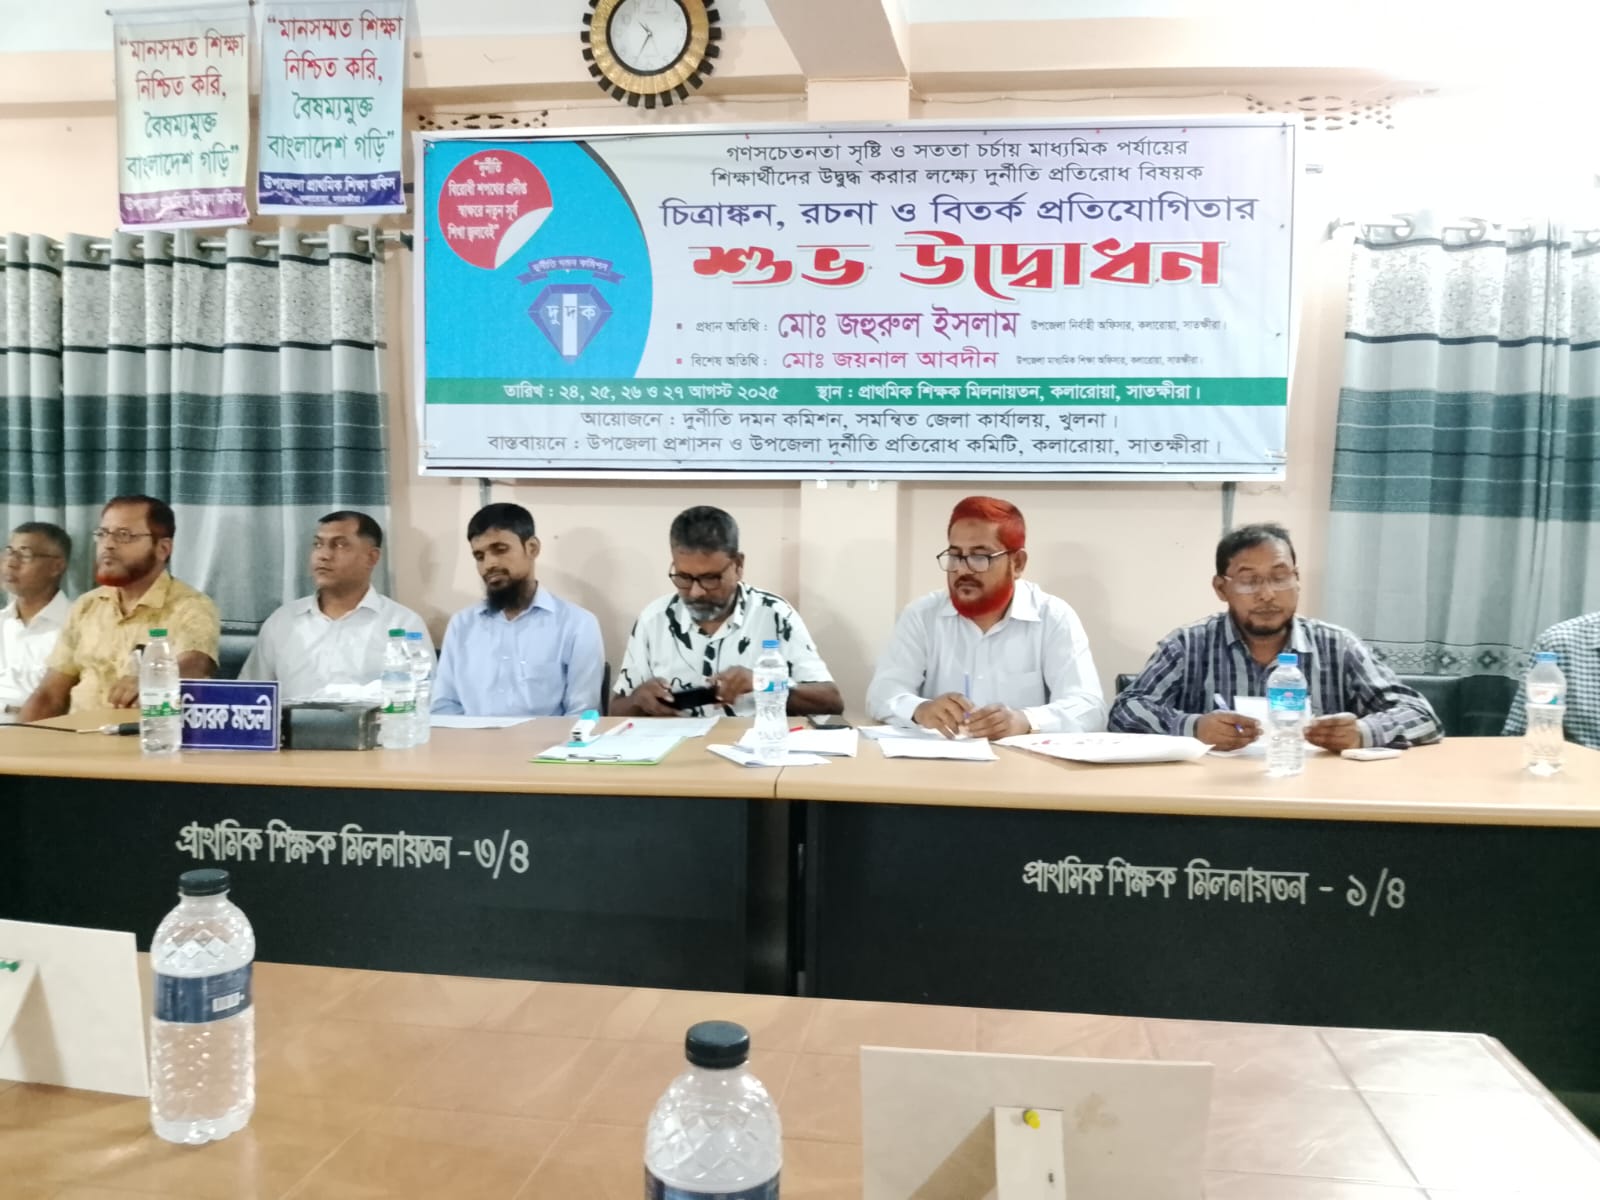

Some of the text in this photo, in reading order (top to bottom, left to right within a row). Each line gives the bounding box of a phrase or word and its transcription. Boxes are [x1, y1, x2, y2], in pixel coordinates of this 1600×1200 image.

[360, 9, 404, 41] শিক্ষা
[204, 28, 245, 58] শিক্ষা
[283, 49, 384, 85] নিশ্চিত করি,
[136, 66, 226, 100] নিশ্চিত করি,
[292, 92, 374, 126] বৈষম্যমুক্ত
[144, 112, 218, 141] বৈষম্যমুক্ত
[268, 135, 347, 161] বাংলাদেশ
[726, 138, 1189, 165] গণসচেতনতা সৃষ্টি ও সততা চর্চায় মাধ্যমিক পর্যায়ের
[126, 152, 193, 178] বাংলাদেশ
[711, 162, 1204, 189] শিক্ষার্থীদের উদ্বুদ্ধ করার লক্ষ্যে দুর্নীতি প্রতিরোধ বিষয়ক
[659, 190, 1260, 231] চিত্রাঙ্কন, রচনা ও বিতর্ক প্রতিযোগিতার
[688, 230, 1226, 301] শুভ উদ্বোধন
[696, 321, 722, 332] প্রধান
[726, 318, 760, 332] অতিথি
[778, 311, 826, 339] মোঃ
[835, 312, 924, 343] জহুরুল
[932, 304, 1021, 341] ইসলাম
[1031, 320, 1066, 331] উপজেলা
[726, 353, 760, 367] অতিথি
[782, 351, 824, 369] মোঃ
[832, 352, 909, 369] জয়নাল
[916, 346, 1000, 369] আবদীন
[503, 380, 544, 398] তারিখ
[559, 384, 585, 401] ২৪,
[590, 384, 616, 401] ২৫,
[621, 384, 642, 398] ২৬
[650, 385, 658, 398] ও
[664, 386, 683, 399] ২৭
[688, 382, 733, 399] আগস্ট
[738, 386, 779, 400] ২০২৫
[815, 385, 843, 402] স্থান
[858, 381, 913, 400] প্রাথমিক
[917, 381, 961, 400] শিক্ষক
[966, 381, 1044, 402] মিলনায়তন,
[1049, 384, 1120, 402] কলারোয়া,
[580, 411, 664, 428] আয়োজনে
[682, 408, 732, 431] দুর্নীতি
[738, 413, 776, 428] দমন
[782, 409, 848, 430] কমিশন,
[855, 409, 919, 428] সমন্বিত
[926, 412, 970, 428] জেলা
[978, 408, 1050, 430] কার্যালয়,
[1058, 411, 1107, 432] খুলনা
[488, 435, 568, 452] বাস্তবায়নে
[587, 433, 658, 452] উপজেলা
[662, 436, 723, 452] প্রশাসন
[730, 438, 743, 450] ও
[750, 434, 821, 453] উপজেলা
[828, 432, 880, 456] দুর্নীতি
[885, 434, 965, 454] প্রতিরোধ
[966, 434, 1024, 456] কমিটি,
[1032, 438, 1119, 456] কলারোয়া,
[176, 819, 263, 861] প্রাথমিক
[266, 819, 338, 865] শিক্ষক
[340, 824, 452, 869] মিলনায়তন
[1022, 855, 1104, 895] প্রাথমিক
[1106, 856, 1178, 898] শিক্ষক
[1184, 858, 1310, 904] মিলনায়তন
